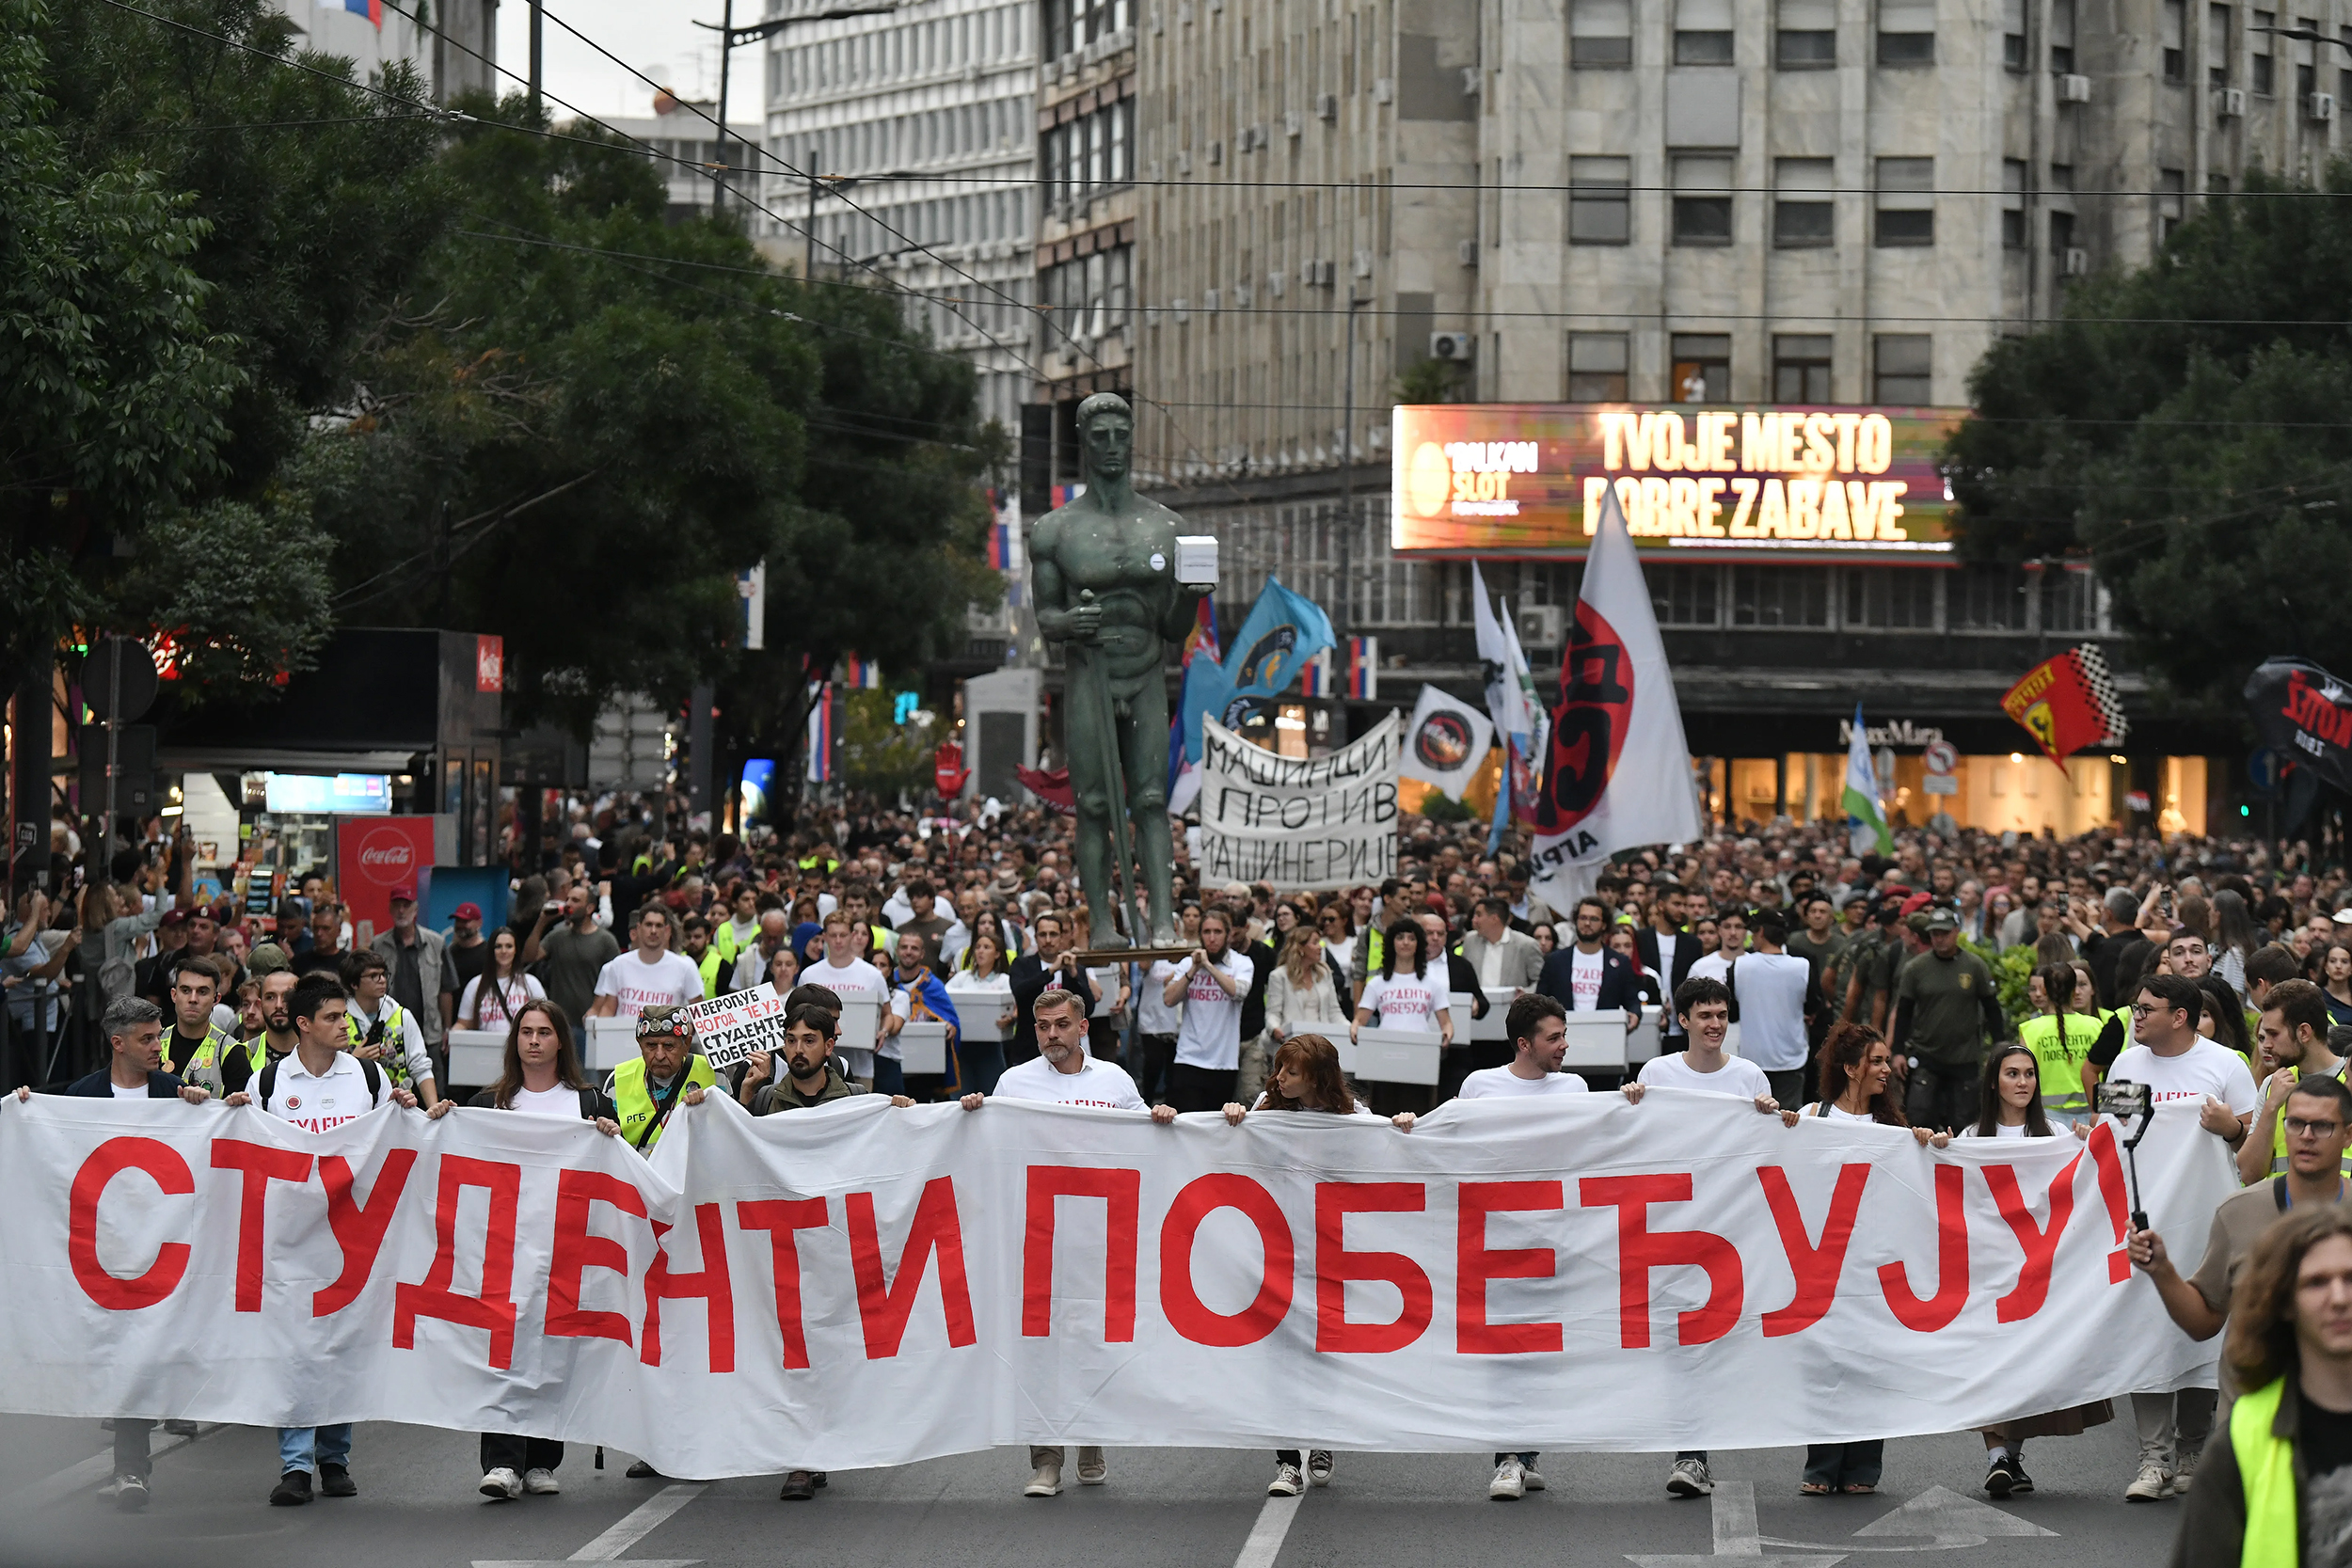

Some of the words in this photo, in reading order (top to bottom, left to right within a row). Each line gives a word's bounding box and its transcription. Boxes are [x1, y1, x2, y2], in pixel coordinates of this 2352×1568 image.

[1599, 411, 1738, 472] TVOJE
[1740, 411, 1892, 474] MESTO
[1452, 471, 1511, 501] SLOT
[1729, 477, 1907, 540] ZABAVE
[1206, 735, 1387, 788] МАШИНЦИ
[1218, 783, 1396, 830] ПРОТИВ
[361, 847, 410, 864] Coca-Cola
[690, 1006, 702, 1020] И
[762, 999, 781, 1014] УЗ
[703, 1014, 784, 1050] СТУДЕНТЕ
[2041, 1035, 2091, 1049] СТУЕНТИ
[627, 1113, 646, 1123] РГБ
[69, 1137, 977, 1373] СТУДЕНТИ
[1023, 1122, 2132, 1354] ПОБЕЂУЈУ!
